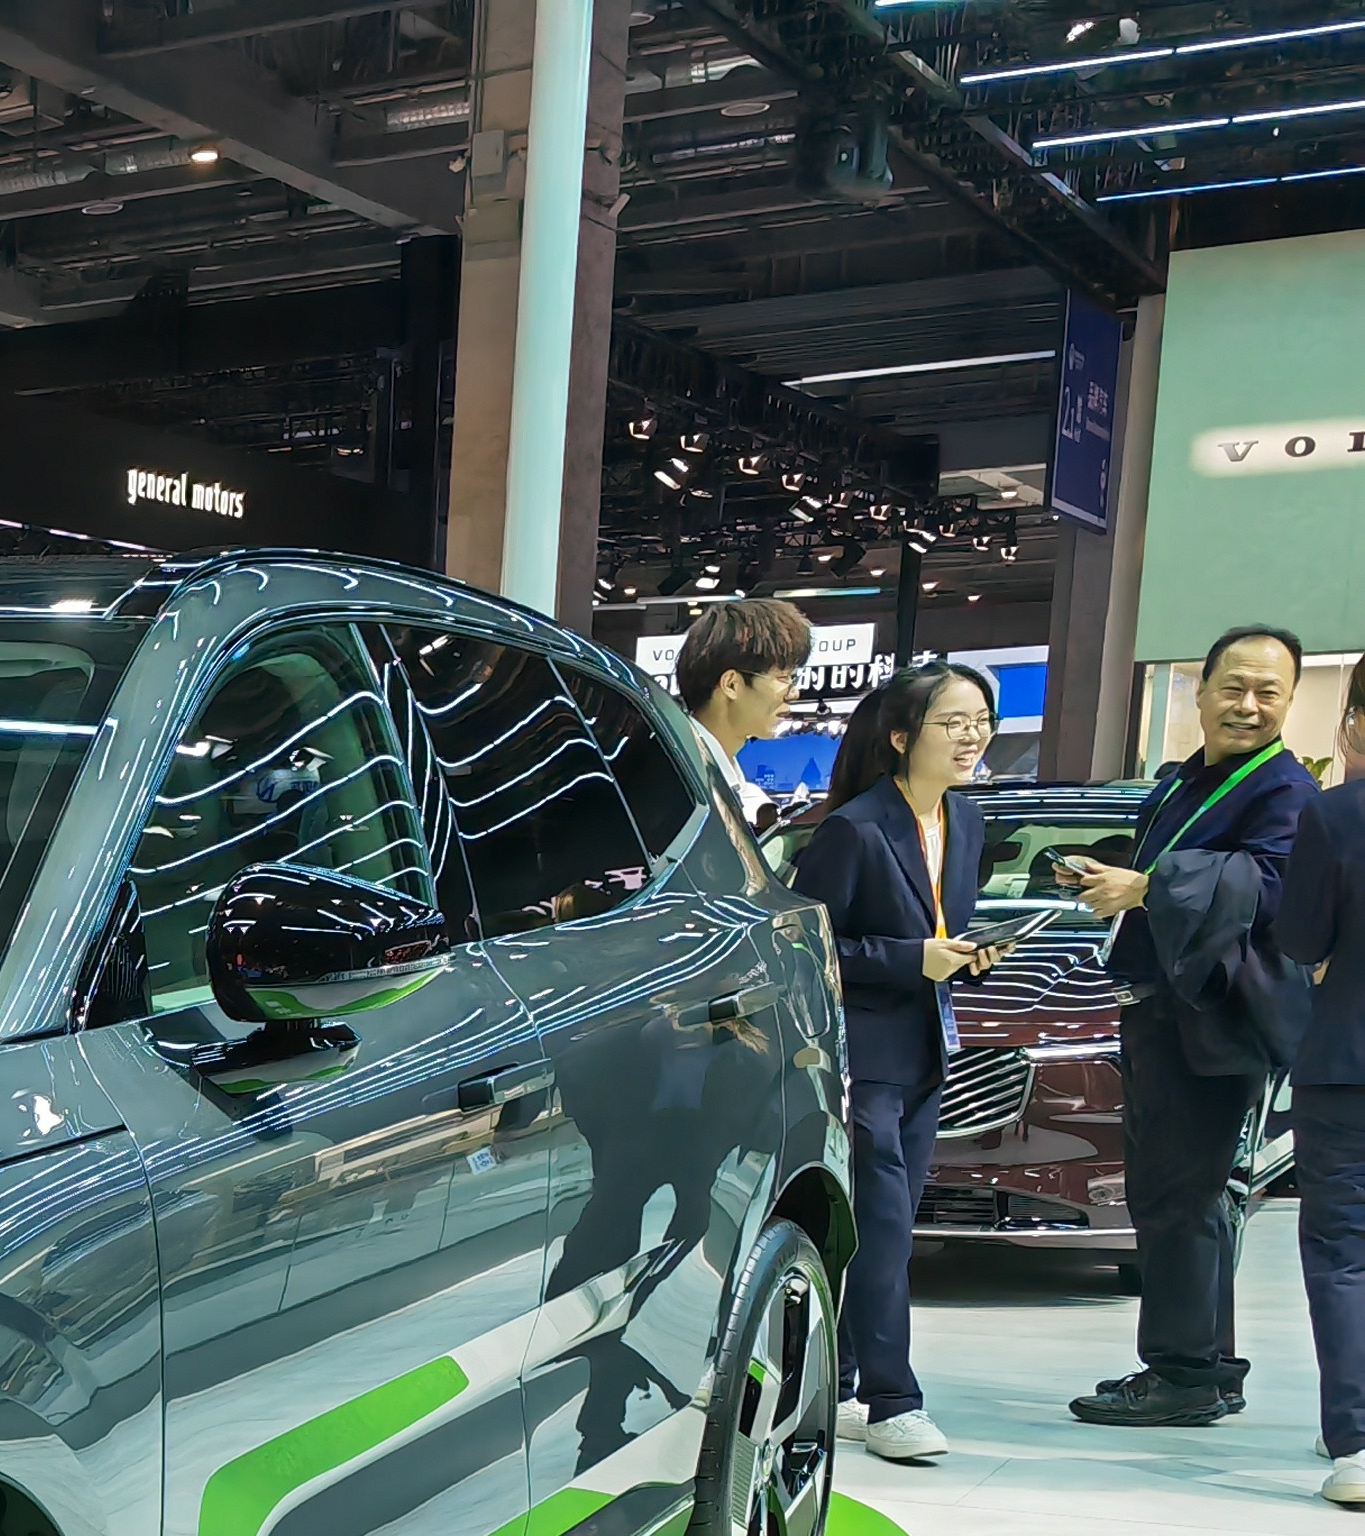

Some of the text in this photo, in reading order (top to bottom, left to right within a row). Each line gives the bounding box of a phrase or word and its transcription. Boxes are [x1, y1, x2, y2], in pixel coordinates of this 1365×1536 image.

[127, 468, 246, 519] general motors
[819, 639, 856, 652] OUP
